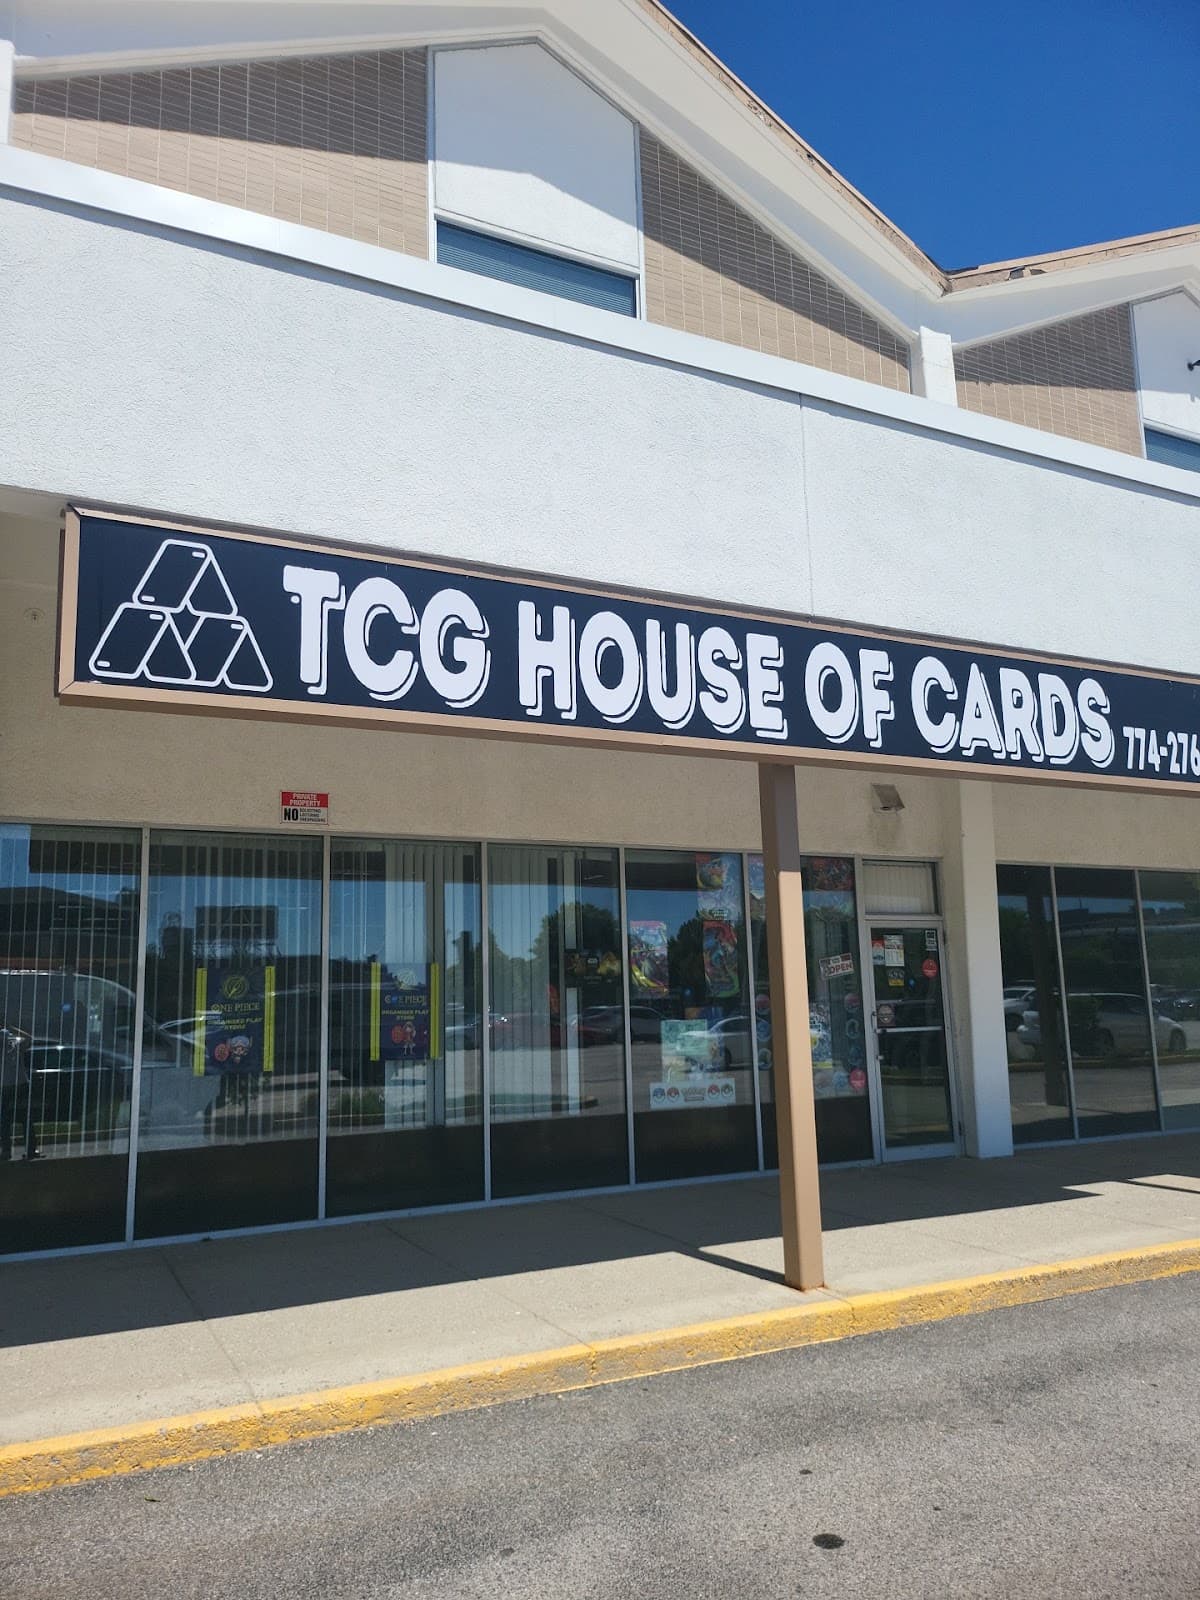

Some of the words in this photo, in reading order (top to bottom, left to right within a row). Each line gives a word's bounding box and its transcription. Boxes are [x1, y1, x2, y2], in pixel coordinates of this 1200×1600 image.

[283, 564, 491, 709] TCG
[518, 600, 788, 740] HOUSE
[805, 641, 895, 748] OF
[911, 655, 1115, 769] CARDS
[289, 799, 321, 807] PROPERTY
[283, 807, 299, 821] NO
[235, 1002, 261, 1012] PIECE
